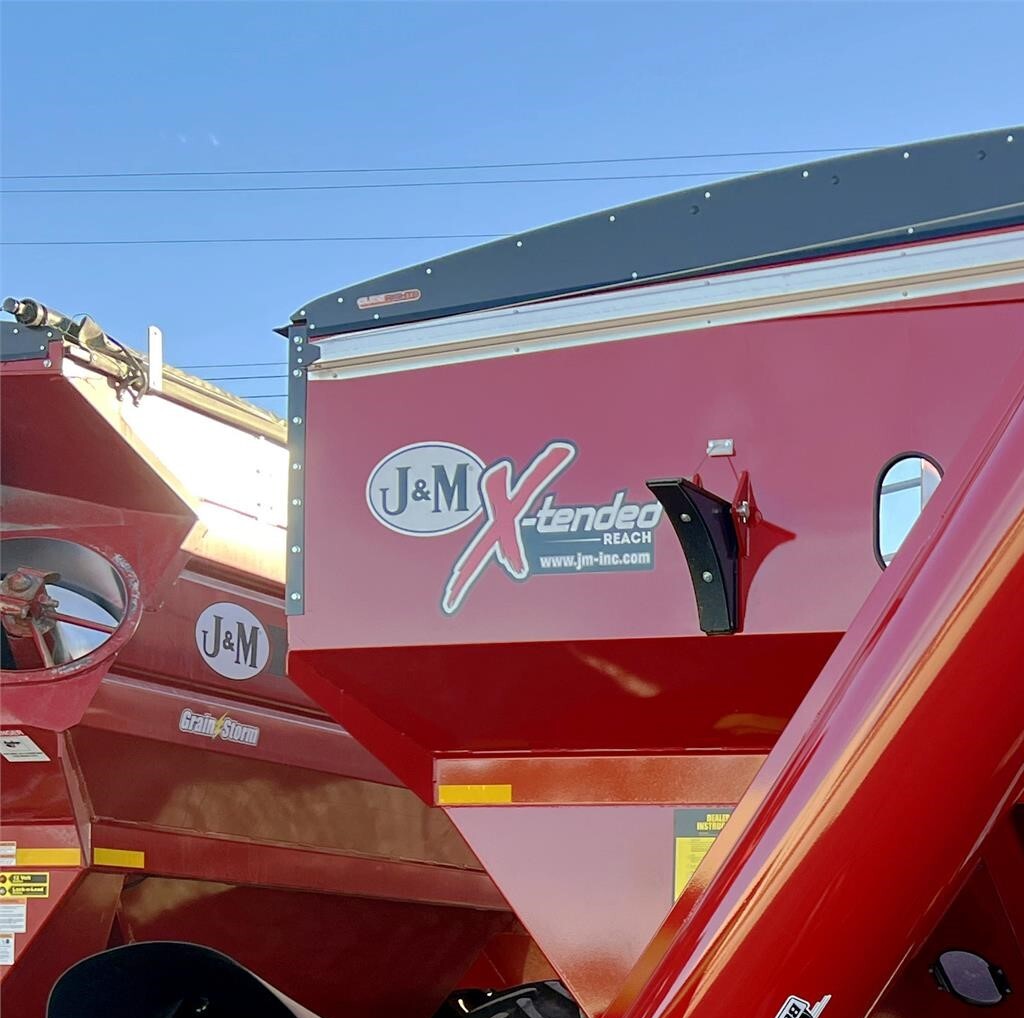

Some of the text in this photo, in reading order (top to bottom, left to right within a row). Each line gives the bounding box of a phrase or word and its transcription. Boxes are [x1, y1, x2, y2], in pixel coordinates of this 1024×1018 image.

[379, 462, 471, 517] J&M
[602, 531, 652, 546] REACH
[539, 551, 651, 571] www.jm-inc.com
[202, 614, 260, 669] J&M
[180, 709, 259, 745] Grain Storm
